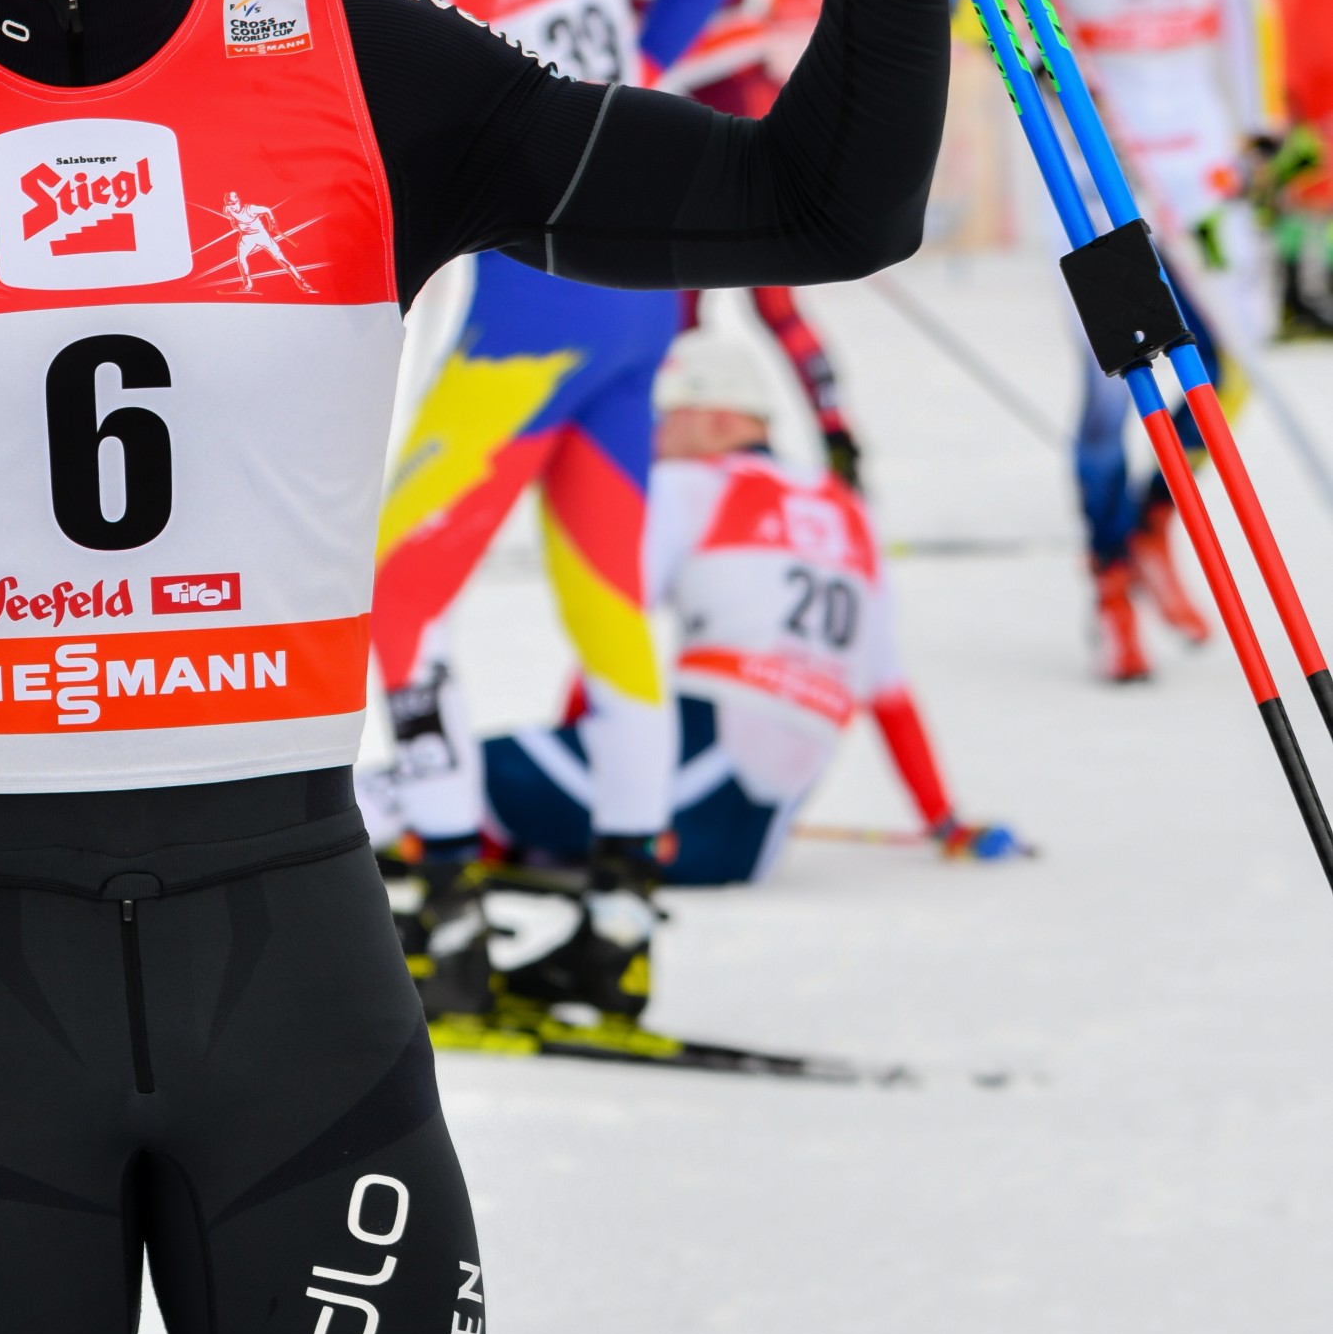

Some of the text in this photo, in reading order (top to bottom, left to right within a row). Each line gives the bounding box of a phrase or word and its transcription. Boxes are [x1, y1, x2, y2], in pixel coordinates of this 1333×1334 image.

[230, 17, 276, 28] CROSS
[230, 19, 297, 36] COUNTRY
[231, 28, 293, 42] WORLD CUP
[56, 156, 117, 165] Salzburger
[20, 157, 153, 241] Stiegl
[45, 333, 173, 551] 6
[784, 565, 861, 652] 20
